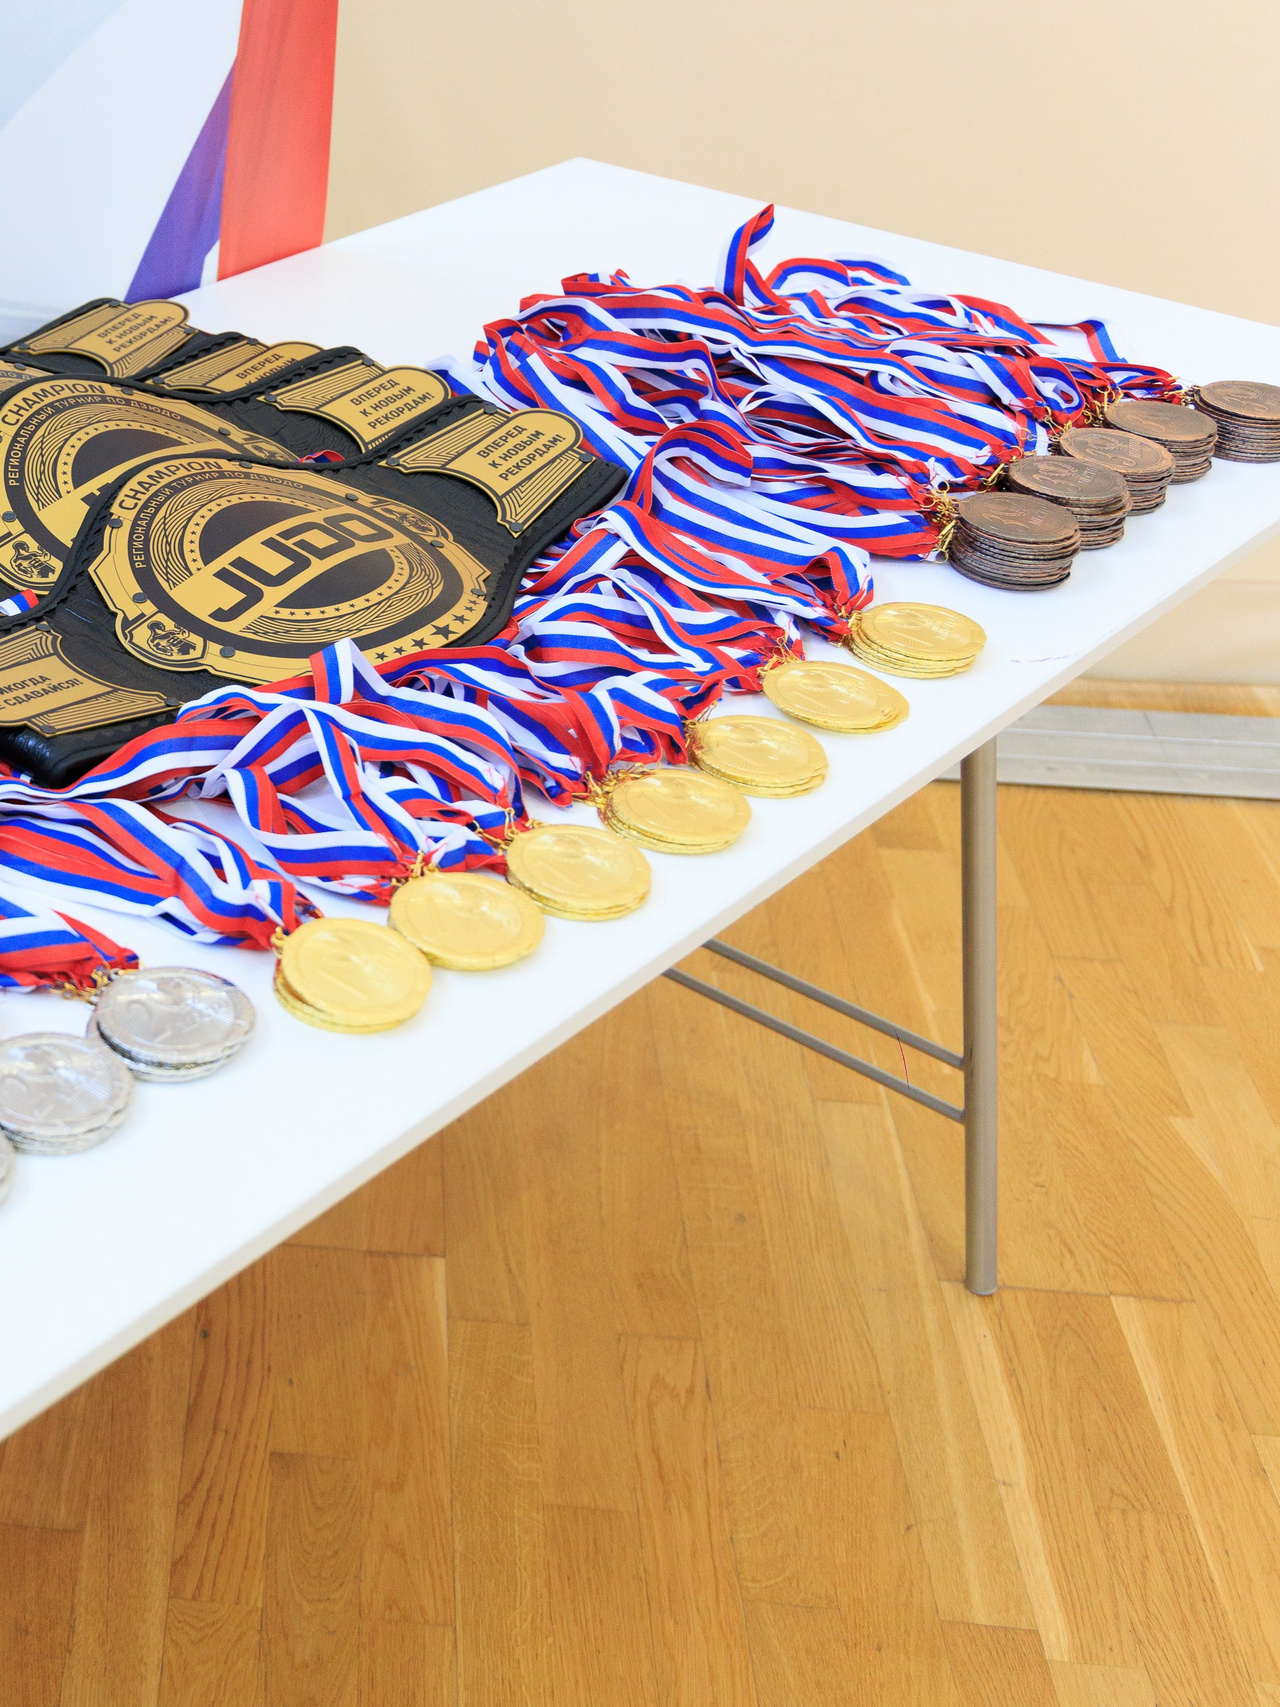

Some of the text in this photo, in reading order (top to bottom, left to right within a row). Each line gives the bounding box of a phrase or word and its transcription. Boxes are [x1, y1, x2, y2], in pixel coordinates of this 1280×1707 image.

[97, 312, 144, 339] ВПЕРЕД
[105, 314, 158, 346] К НОВЫМ
[113, 316, 175, 353] РЕКОРДАМ!
[235, 353, 285, 379] ВПЕРЕД
[1, 382, 106, 427] CHAMPION
[349, 378, 400, 407] ВПЕРЕД
[359, 385, 417, 418] К НОВЫМ
[367, 391, 436, 430] РЕКОРДАМ!
[8, 395, 182, 487] РЕГИОНАЛЬНЫЙ ТУРНИР ПО ДЗЮДО
[476, 424, 528, 459] ВПЕРЕД
[488, 429, 546, 470] К НОВЫМ
[498, 433, 567, 482] РЕКОРДАМ!
[118, 460, 224, 512] CHAMPION
[131, 470, 305, 570] РЕГИОНАЛЬНЫЙ ТУРНИР ПО ДЗЮДО
[207, 511, 395, 622] JUDO
[3, 677, 85, 706] СДАВАЙСЯ!
